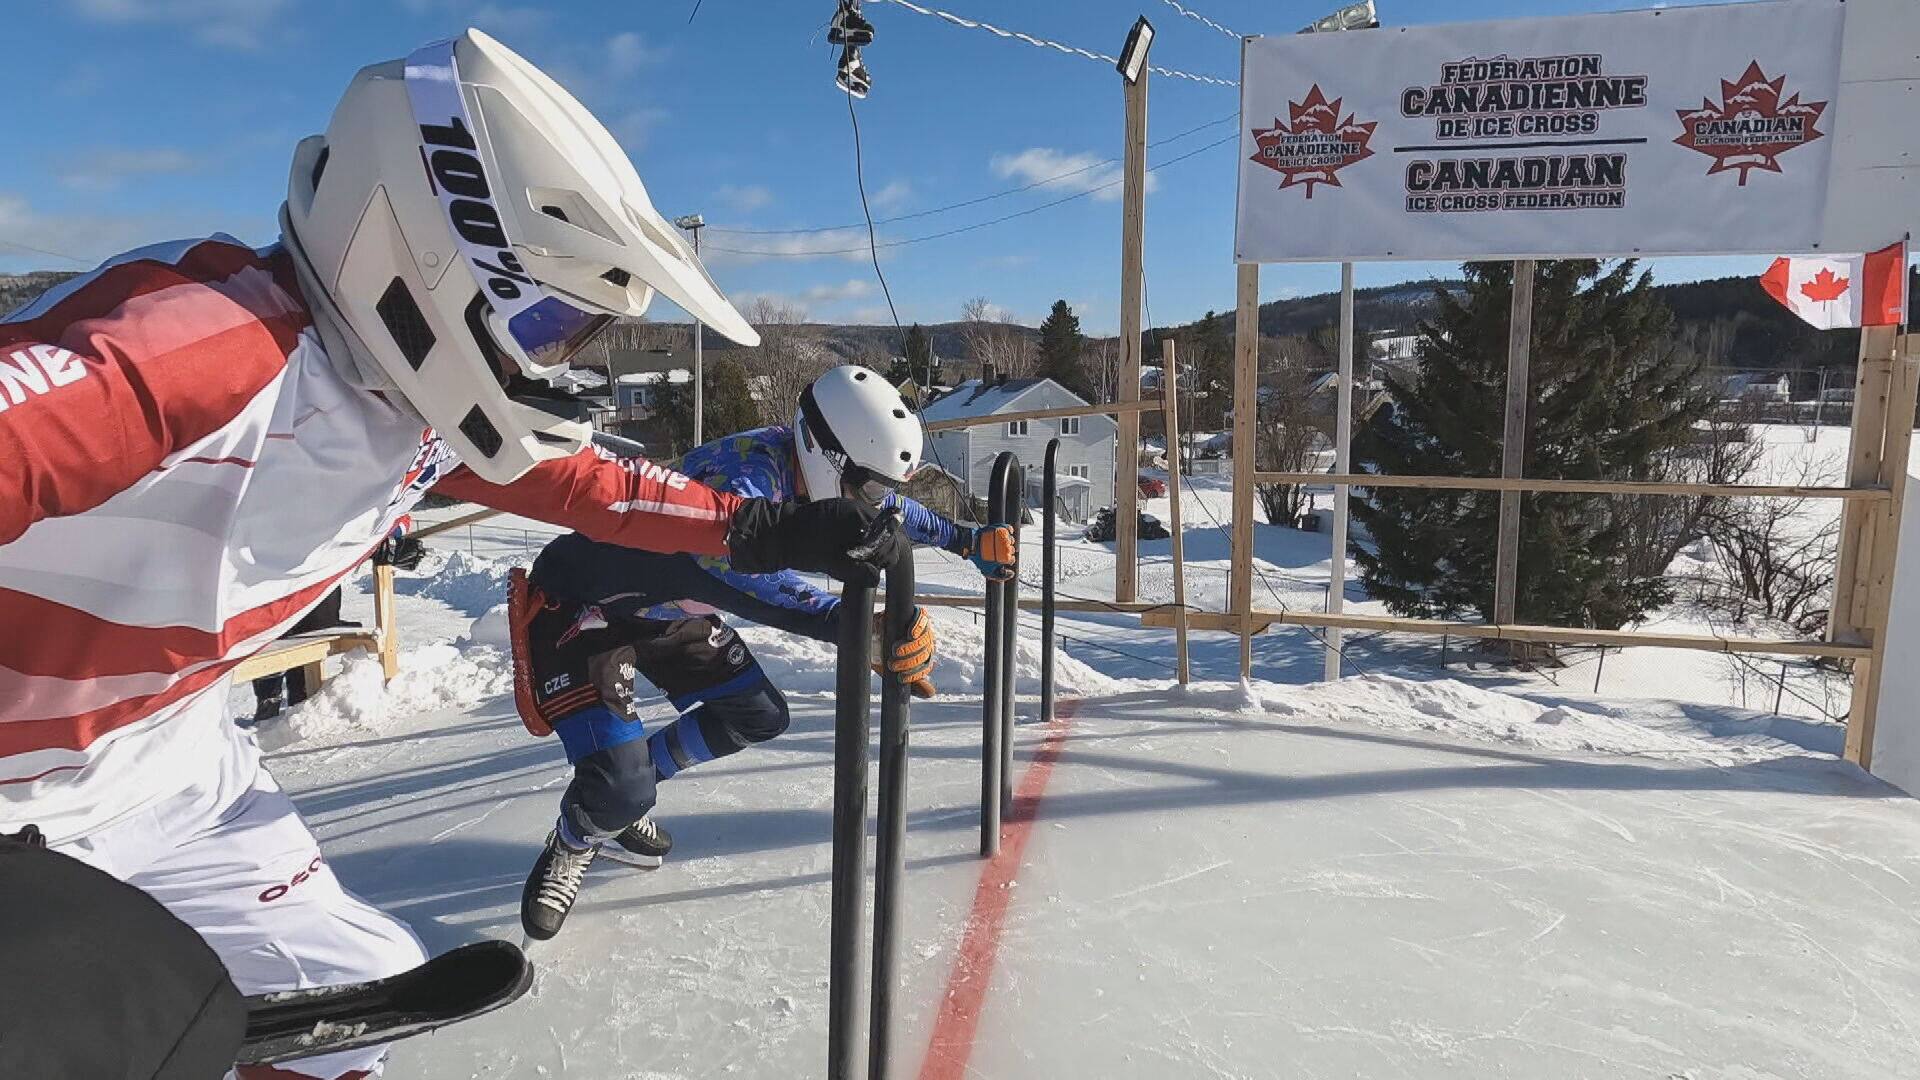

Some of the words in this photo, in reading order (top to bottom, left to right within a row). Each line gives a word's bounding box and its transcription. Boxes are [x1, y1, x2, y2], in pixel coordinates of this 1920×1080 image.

[1401, 76, 1647, 117] CANADIENNE
[1437, 117, 1471, 138] DE
[1472, 116, 1514, 137] ICE
[1517, 112, 1598, 134] CROSS
[1696, 117, 1803, 134] CANADIAN
[1264, 143, 1360, 156] CANADIENNE
[1712, 136, 1741, 144] CROSS
[1744, 134, 1803, 143] FEDERATION
[1293, 158, 1308, 166] ICE
[1311, 156, 1342, 165] CROSS
[1407, 155, 1625, 190] CANADIAN
[420, 116, 533, 299] 100%
[1408, 195, 1436, 212] ICE
[1439, 194, 1499, 211] CROSS
[1503, 191, 1623, 209] FEDERATION
[544, 673, 571, 695] CZE
